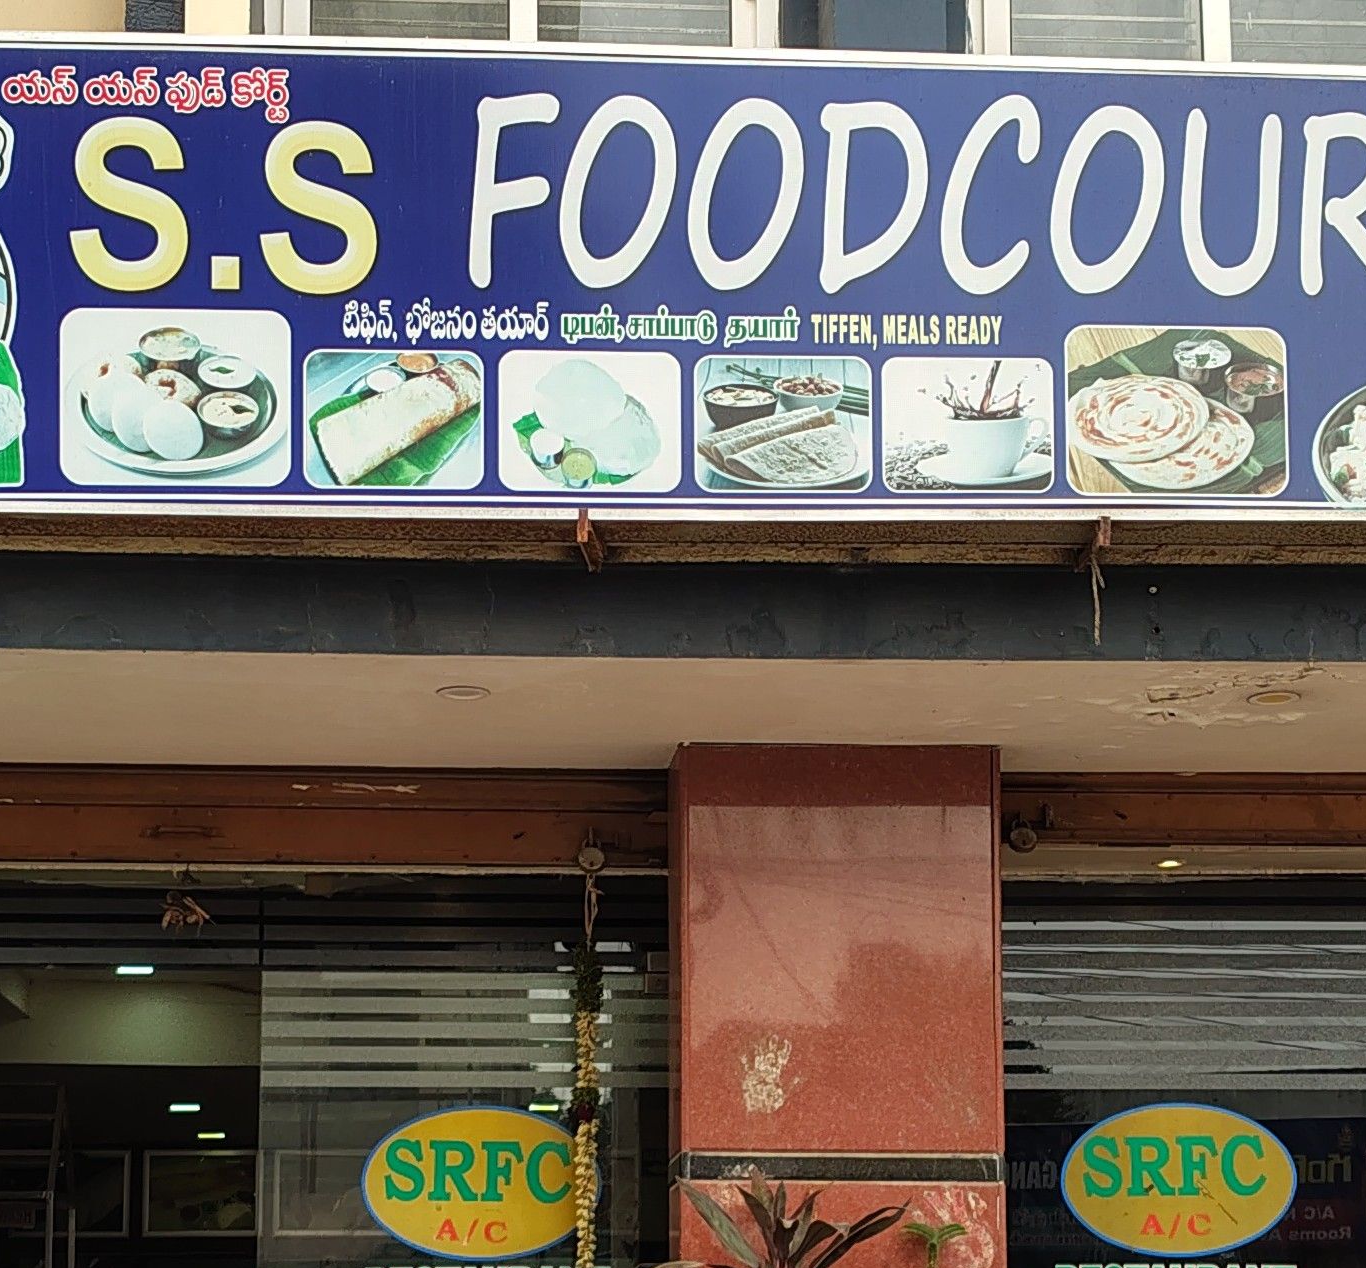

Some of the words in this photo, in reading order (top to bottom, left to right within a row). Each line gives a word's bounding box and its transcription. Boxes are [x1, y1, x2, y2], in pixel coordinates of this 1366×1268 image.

[2, 66, 78, 104] యస్
[83, 67, 160, 105] యస్
[68, 115, 378, 296] S.S
[405, 297, 477, 345] భోజనం
[724, 306, 800, 348] தயார்
[810, 313, 878, 350] TIFFEN,
[883, 314, 940, 345] MEALS
[945, 315, 1003, 345] READY
[384, 1138, 572, 1204] SRFC
[1082, 1134, 1268, 1198] SRFC
[435, 1218, 508, 1246] A/C
[1139, 1213, 1212, 1240] A/C
